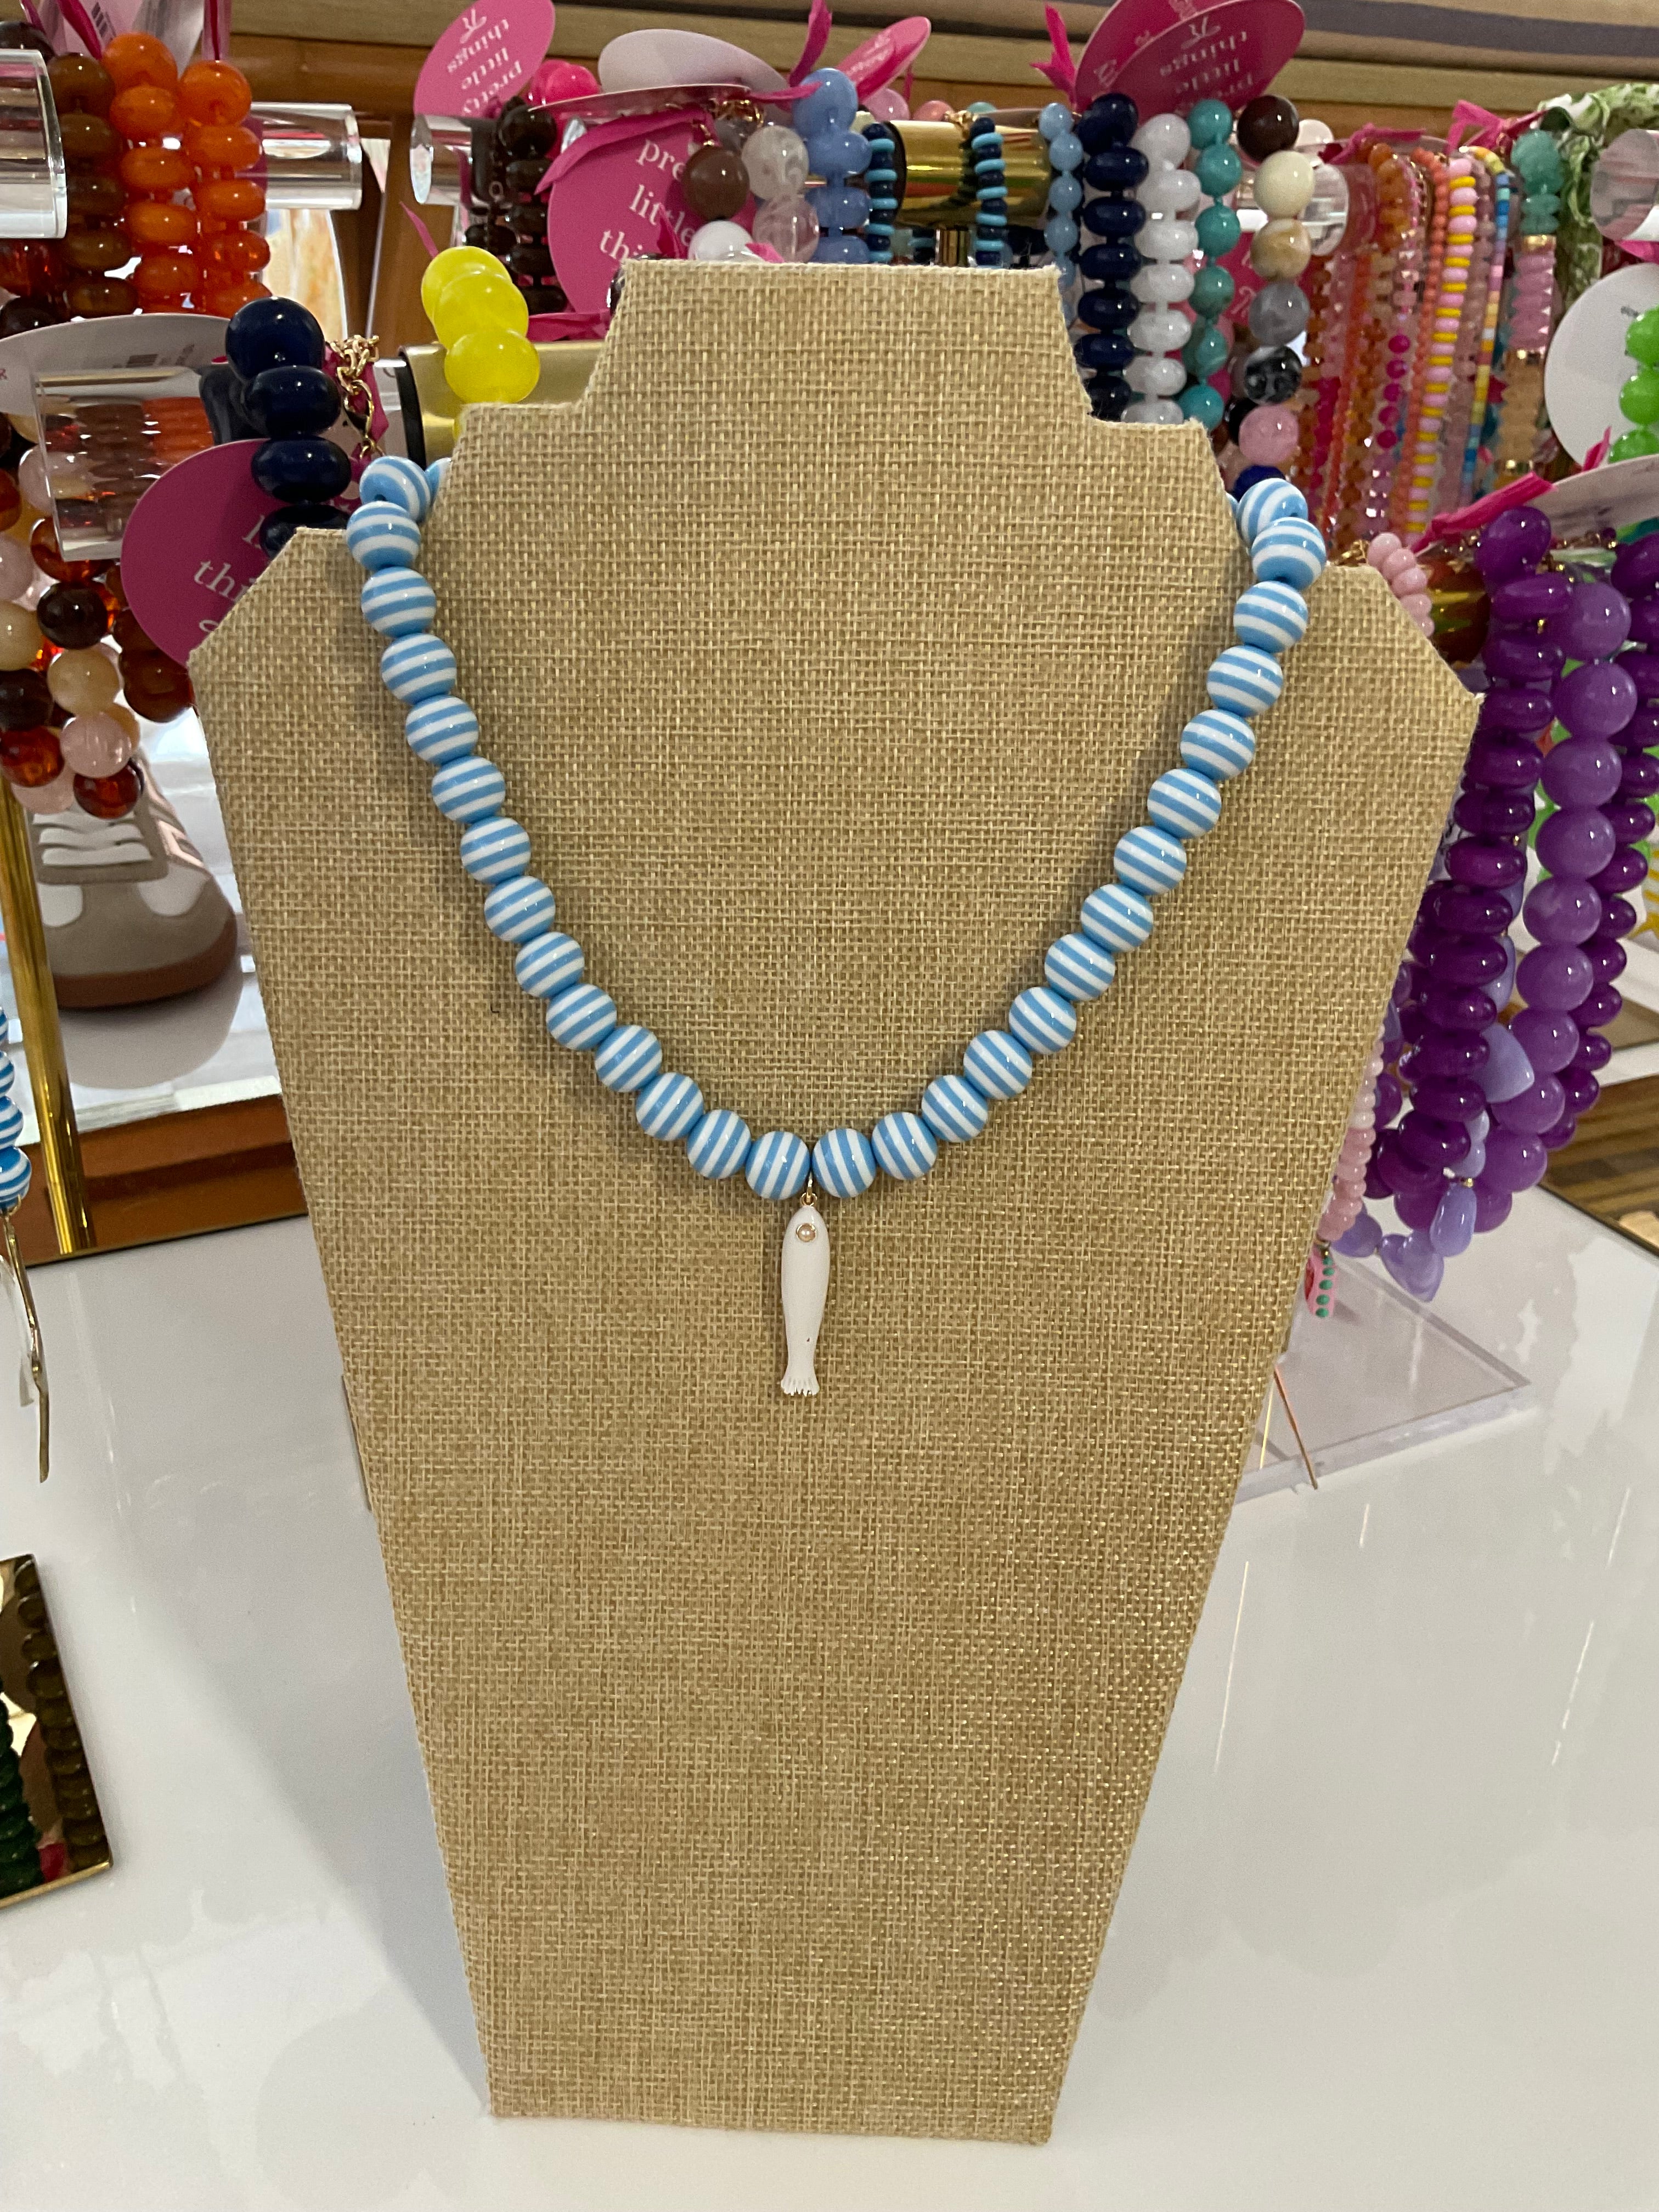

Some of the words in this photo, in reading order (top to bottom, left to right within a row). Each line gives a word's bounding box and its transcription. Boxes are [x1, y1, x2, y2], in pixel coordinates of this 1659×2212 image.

[447, 19, 509, 73] things
[462, 47, 509, 89] little
[636, 139, 685, 180] pre
[194, 560, 256, 602] thi
